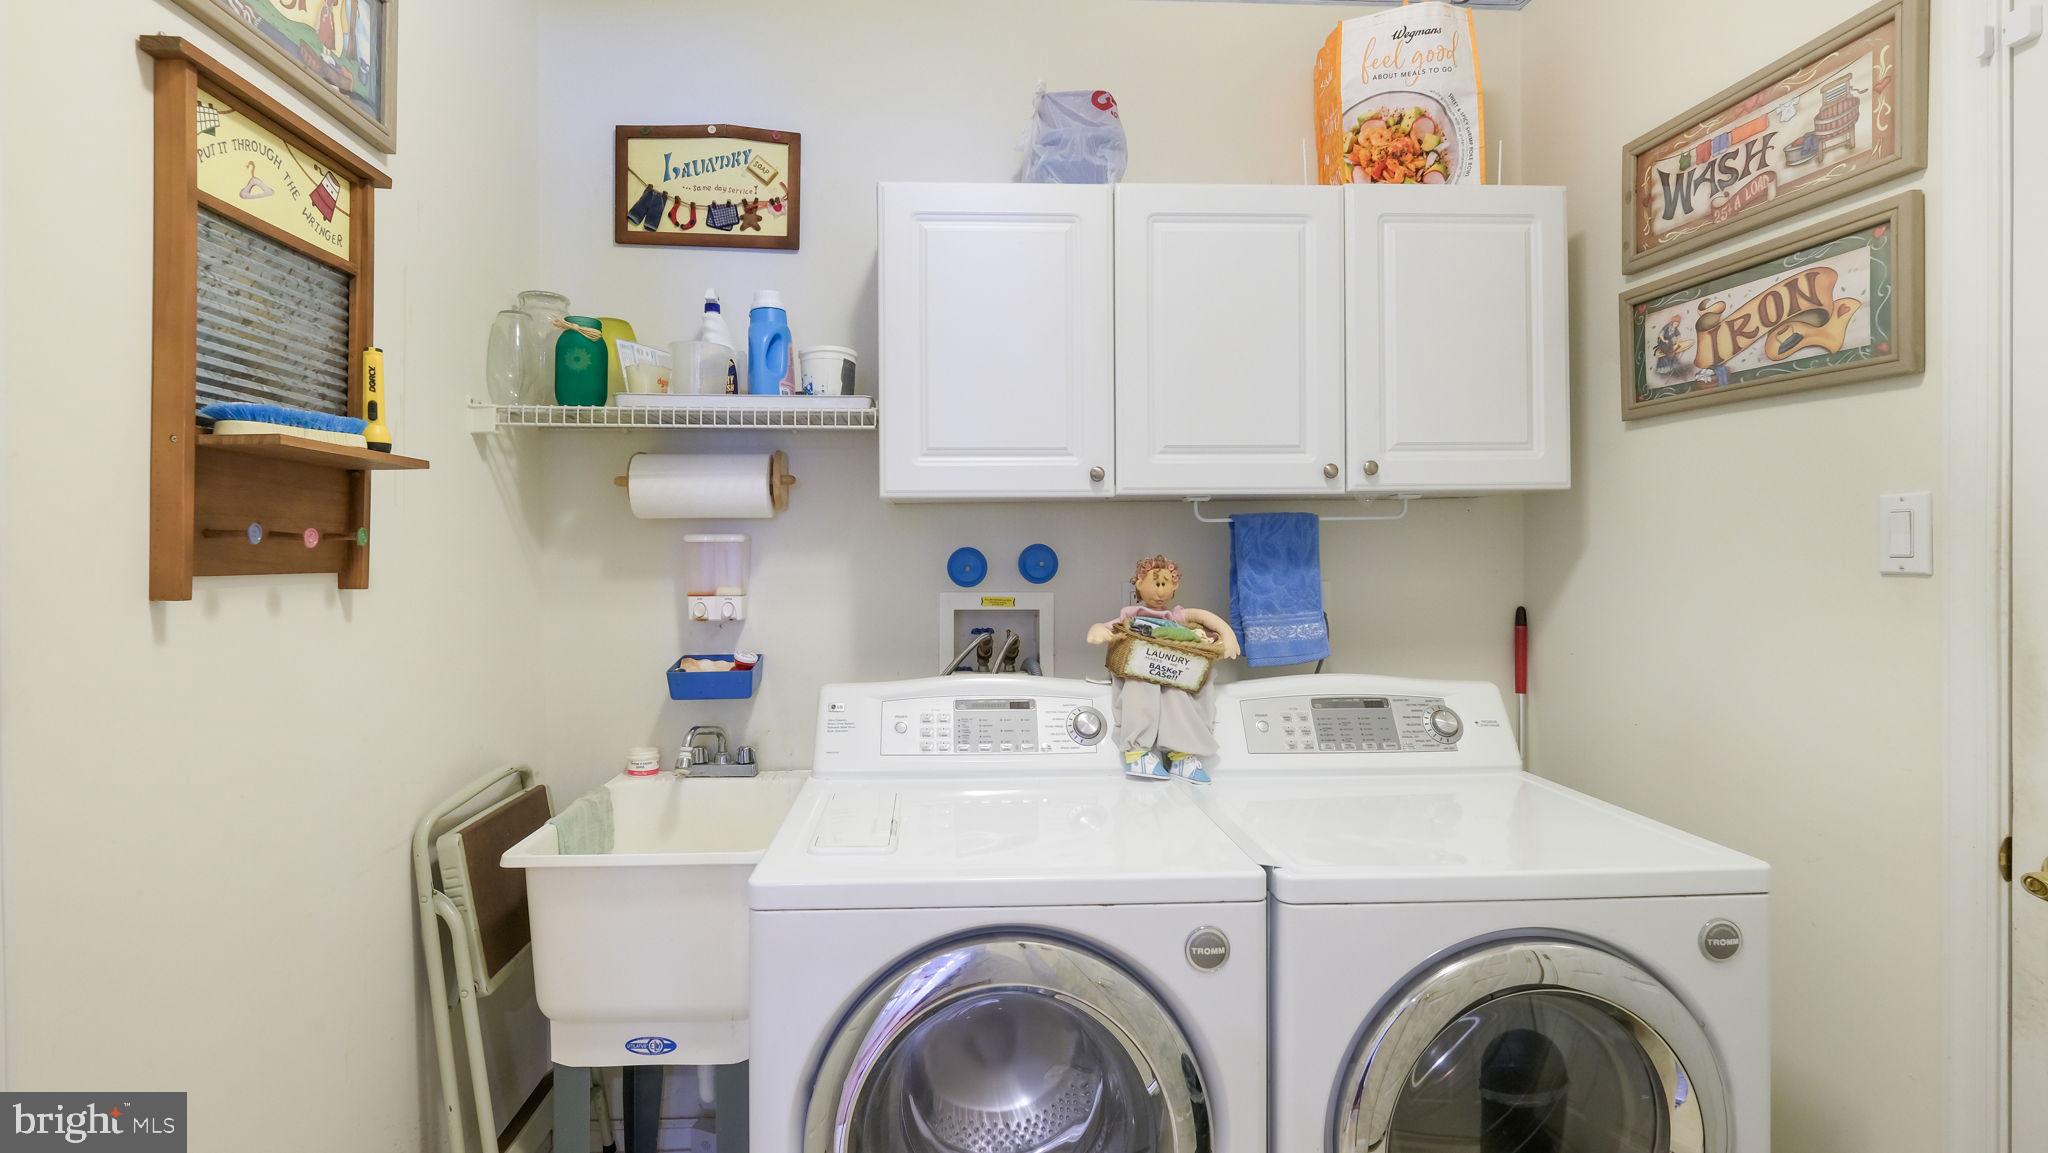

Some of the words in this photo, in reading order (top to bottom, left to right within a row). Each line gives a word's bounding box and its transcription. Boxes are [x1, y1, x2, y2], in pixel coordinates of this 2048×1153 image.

[1391, 25, 1442, 44] Wegmans
[1361, 36, 1406, 85] feel
[1404, 31, 1460, 88] good
[1372, 72, 1398, 81] ABOUT
[1400, 69, 1426, 78] MEALS
[1429, 66, 1440, 74] TO
[663, 149, 753, 183] LAUNDRY
[752, 161, 770, 176] SOAP
[1656, 131, 1778, 220] WASH
[197, 143, 216, 163] PUT
[217, 141, 229, 155] IT
[231, 138, 283, 170] THROUGH
[283, 171, 301, 201] THE
[302, 207, 343, 248] WRINGER
[714, 185, 727, 194] day
[728, 184, 759, 196] service!
[1734, 195, 1742, 211] A
[1744, 174, 1770, 201] LOAD
[1708, 271, 1824, 365] IRON
[1145, 648, 1190, 666] LAUNDRY
[1191, 946, 1226, 955] TROMM
[1707, 938, 1739, 946] TROMM
